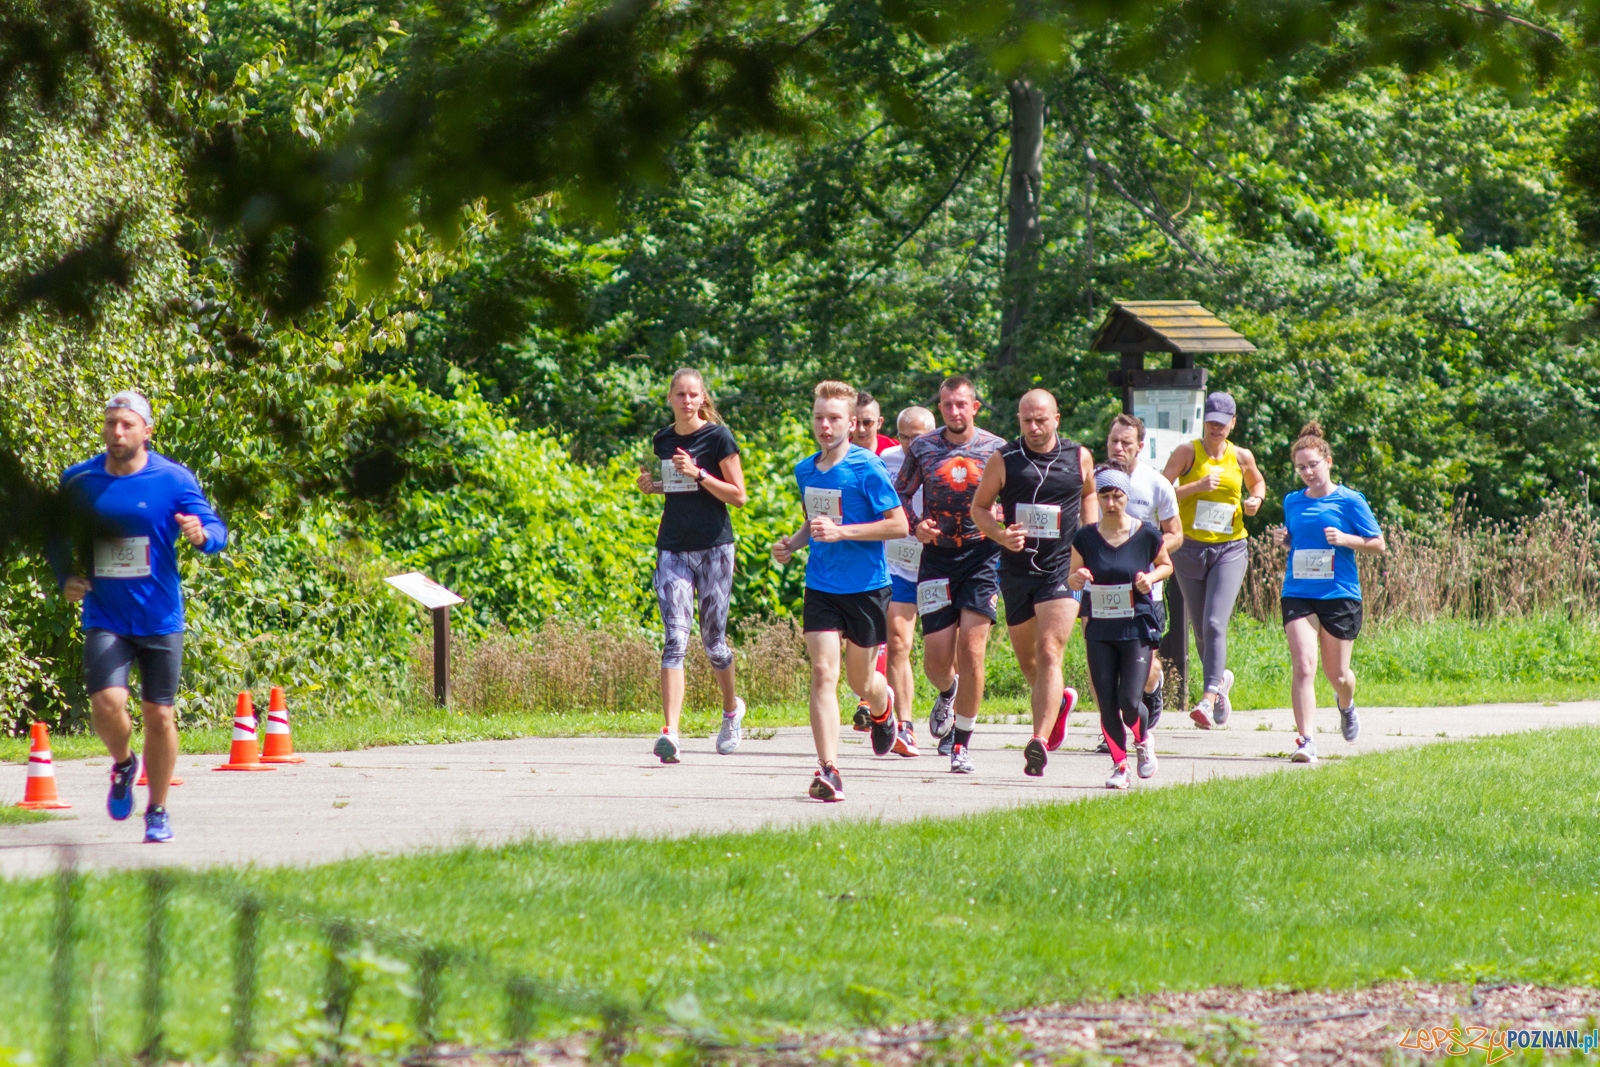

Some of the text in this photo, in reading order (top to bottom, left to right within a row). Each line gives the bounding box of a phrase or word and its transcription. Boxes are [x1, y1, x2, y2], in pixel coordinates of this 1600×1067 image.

[813, 497, 831, 510] 213
[1028, 512, 1049, 524] 198
[1208, 509, 1225, 520] 174
[109, 547, 135, 561] 168
[898, 546, 916, 558] 159
[1305, 556, 1324, 567] 173
[920, 588, 938, 600] 184
[1101, 593, 1121, 605] 190
